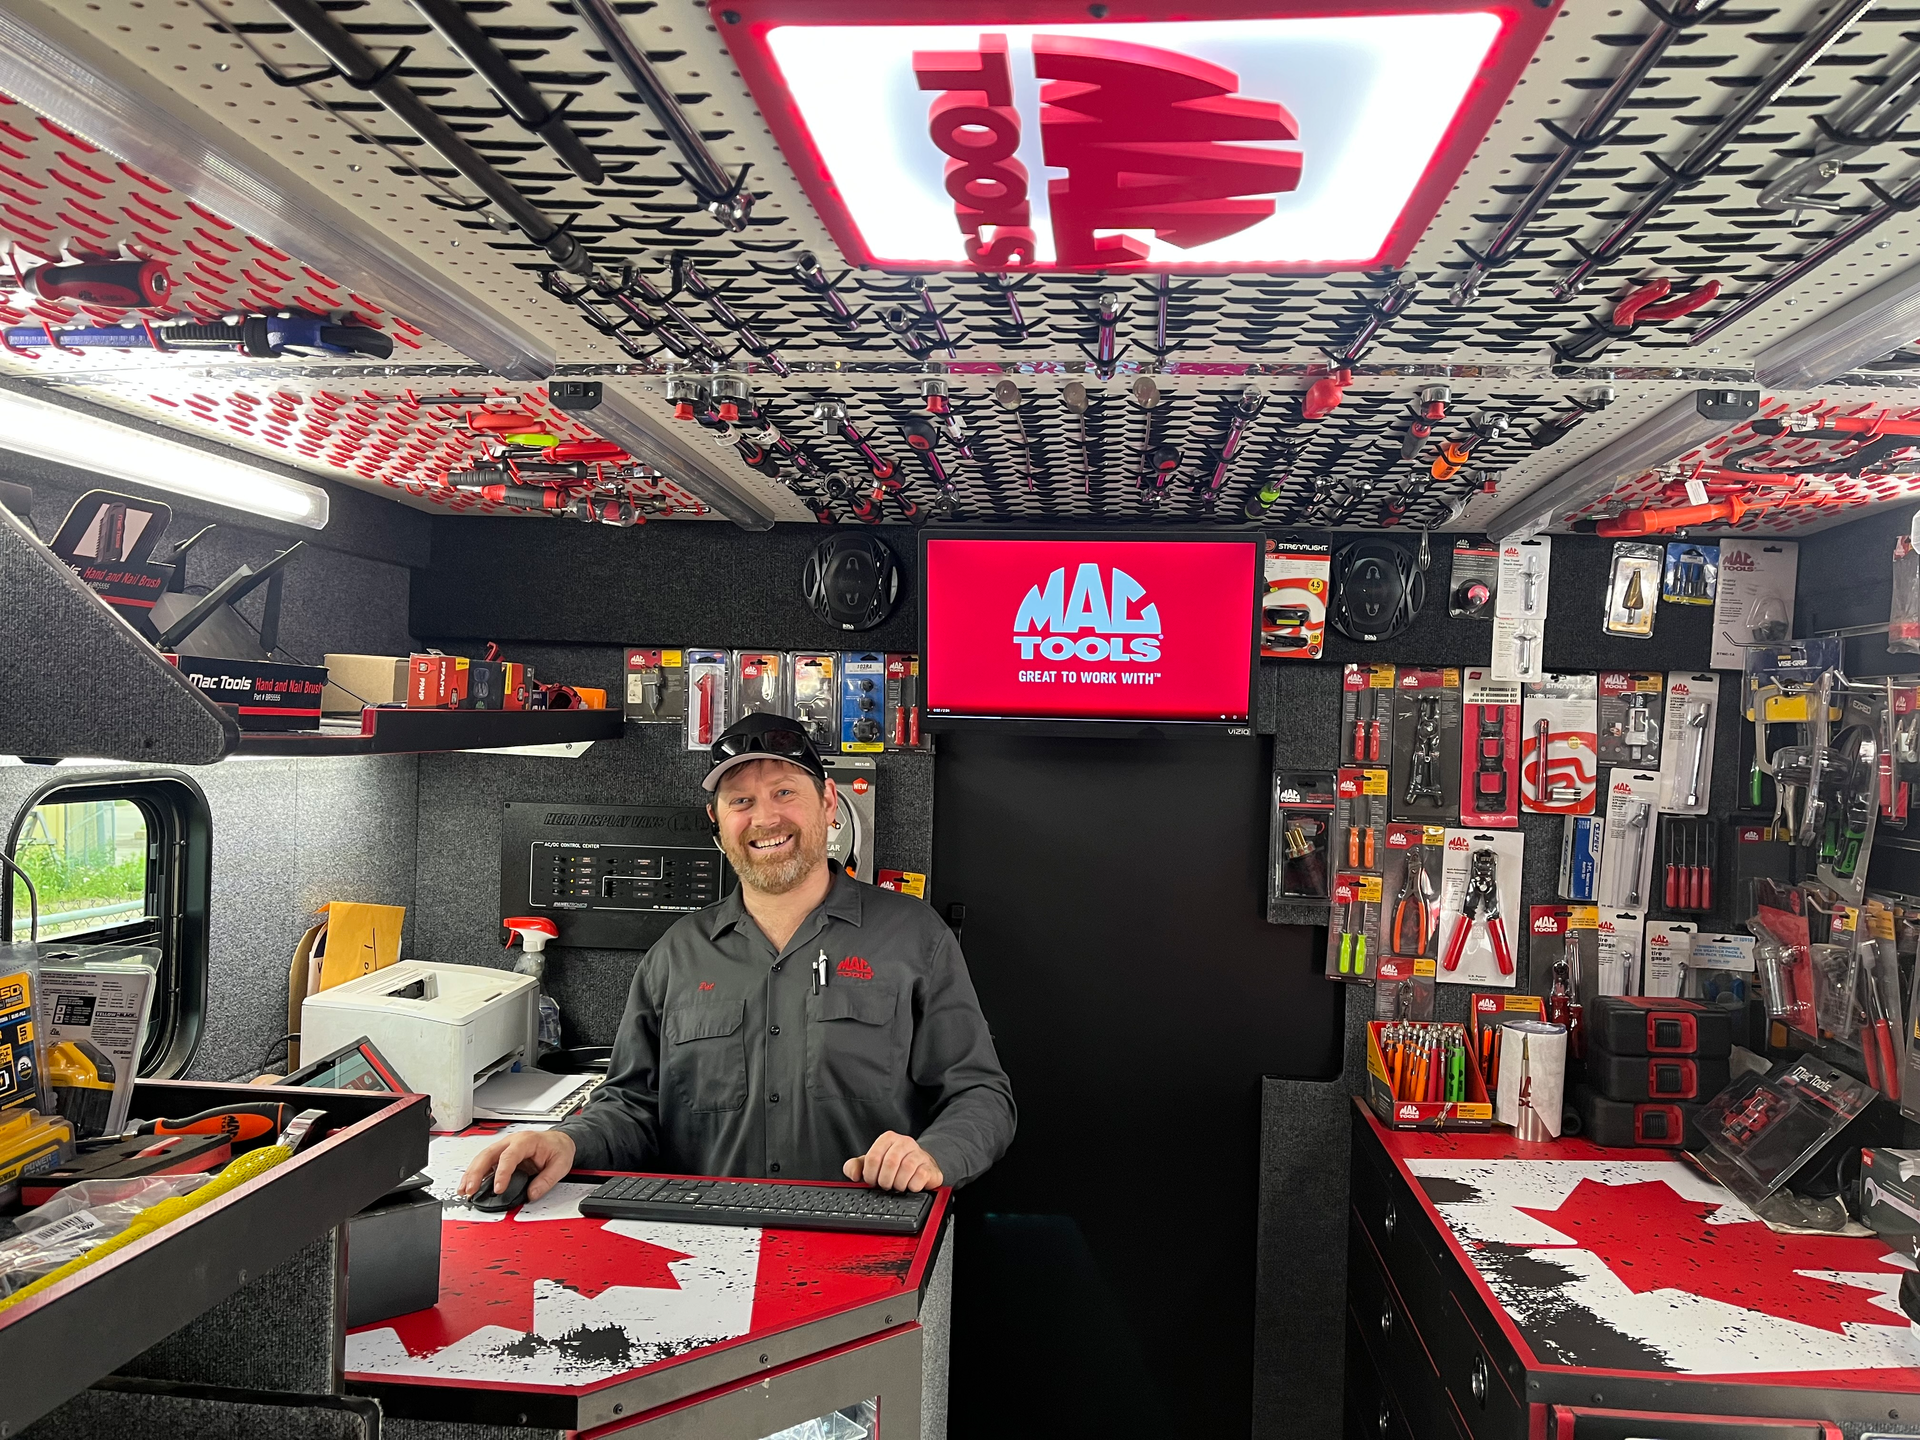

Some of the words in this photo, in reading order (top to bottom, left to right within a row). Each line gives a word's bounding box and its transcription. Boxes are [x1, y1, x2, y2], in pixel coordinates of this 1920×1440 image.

[912, 33, 1036, 266] TOOLS
[1032, 34, 1303, 266] MAC
[1278, 543, 1328, 551] STREAMLIGHT
[1722, 550, 1754, 566] MAC
[84, 567, 107, 582] Hand
[105, 570, 122, 583] and
[122, 571, 140, 585] Nail
[139, 575, 161, 588] Brush
[1013, 563, 1162, 634] MAC
[1013, 636, 1162, 663] TOOLS
[188, 673, 219, 689] Mac
[220, 675, 252, 690] Tools
[255, 677, 273, 691] Hand
[274, 679, 287, 692] and
[289, 679, 303, 692] Nail
[305, 681, 323, 694] Brush
[1018, 670, 1056, 683] GREAT
[1061, 671, 1077, 684] TO
[1081, 671, 1117, 685] WORK
[1604, 674, 1627, 685] MAC
[418, 677, 426, 700] PPAMP
[1670, 683, 1689, 692] MAC
[1613, 782, 1632, 791] MAC
[544, 813, 578, 826] HERR
[578, 814, 631, 828] DISPLAY
[631, 815, 665, 828] VANS
[1448, 836, 1469, 847] MAC
[1534, 916, 1558, 927] MAC
[1650, 934, 1669, 943] MAC
[836, 956, 873, 972] MAC
[19, 1026, 26, 1037] 5
[1792, 1065, 1811, 1083] Mac
[1809, 1074, 1833, 1093] Tools
[1400, 1104, 1419, 1114] MAC
[24, 1153, 52, 1173] POWER
